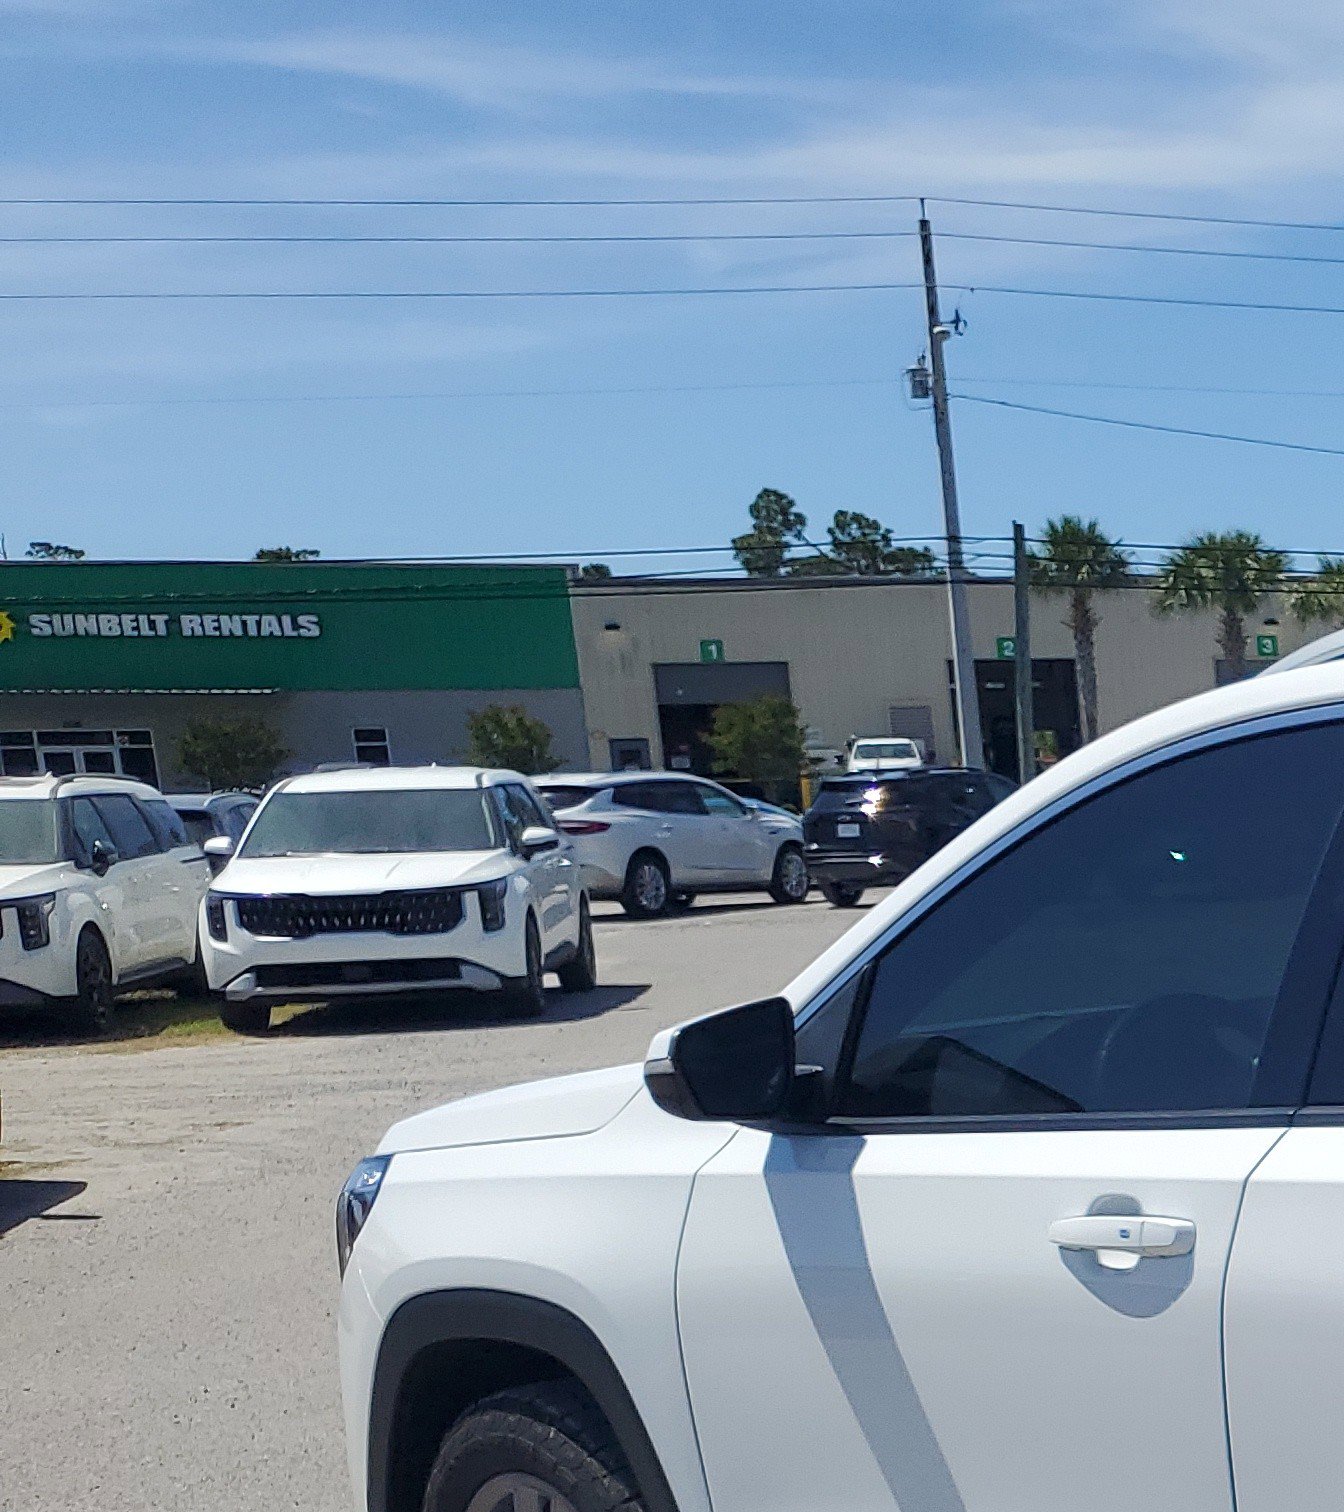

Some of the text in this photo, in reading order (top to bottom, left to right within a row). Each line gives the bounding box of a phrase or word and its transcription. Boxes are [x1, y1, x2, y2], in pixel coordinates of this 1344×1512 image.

[28, 613, 321, 638] SUNBELT RENTALS
[707, 642, 718, 660] 1
[1003, 641, 1015, 657] 2
